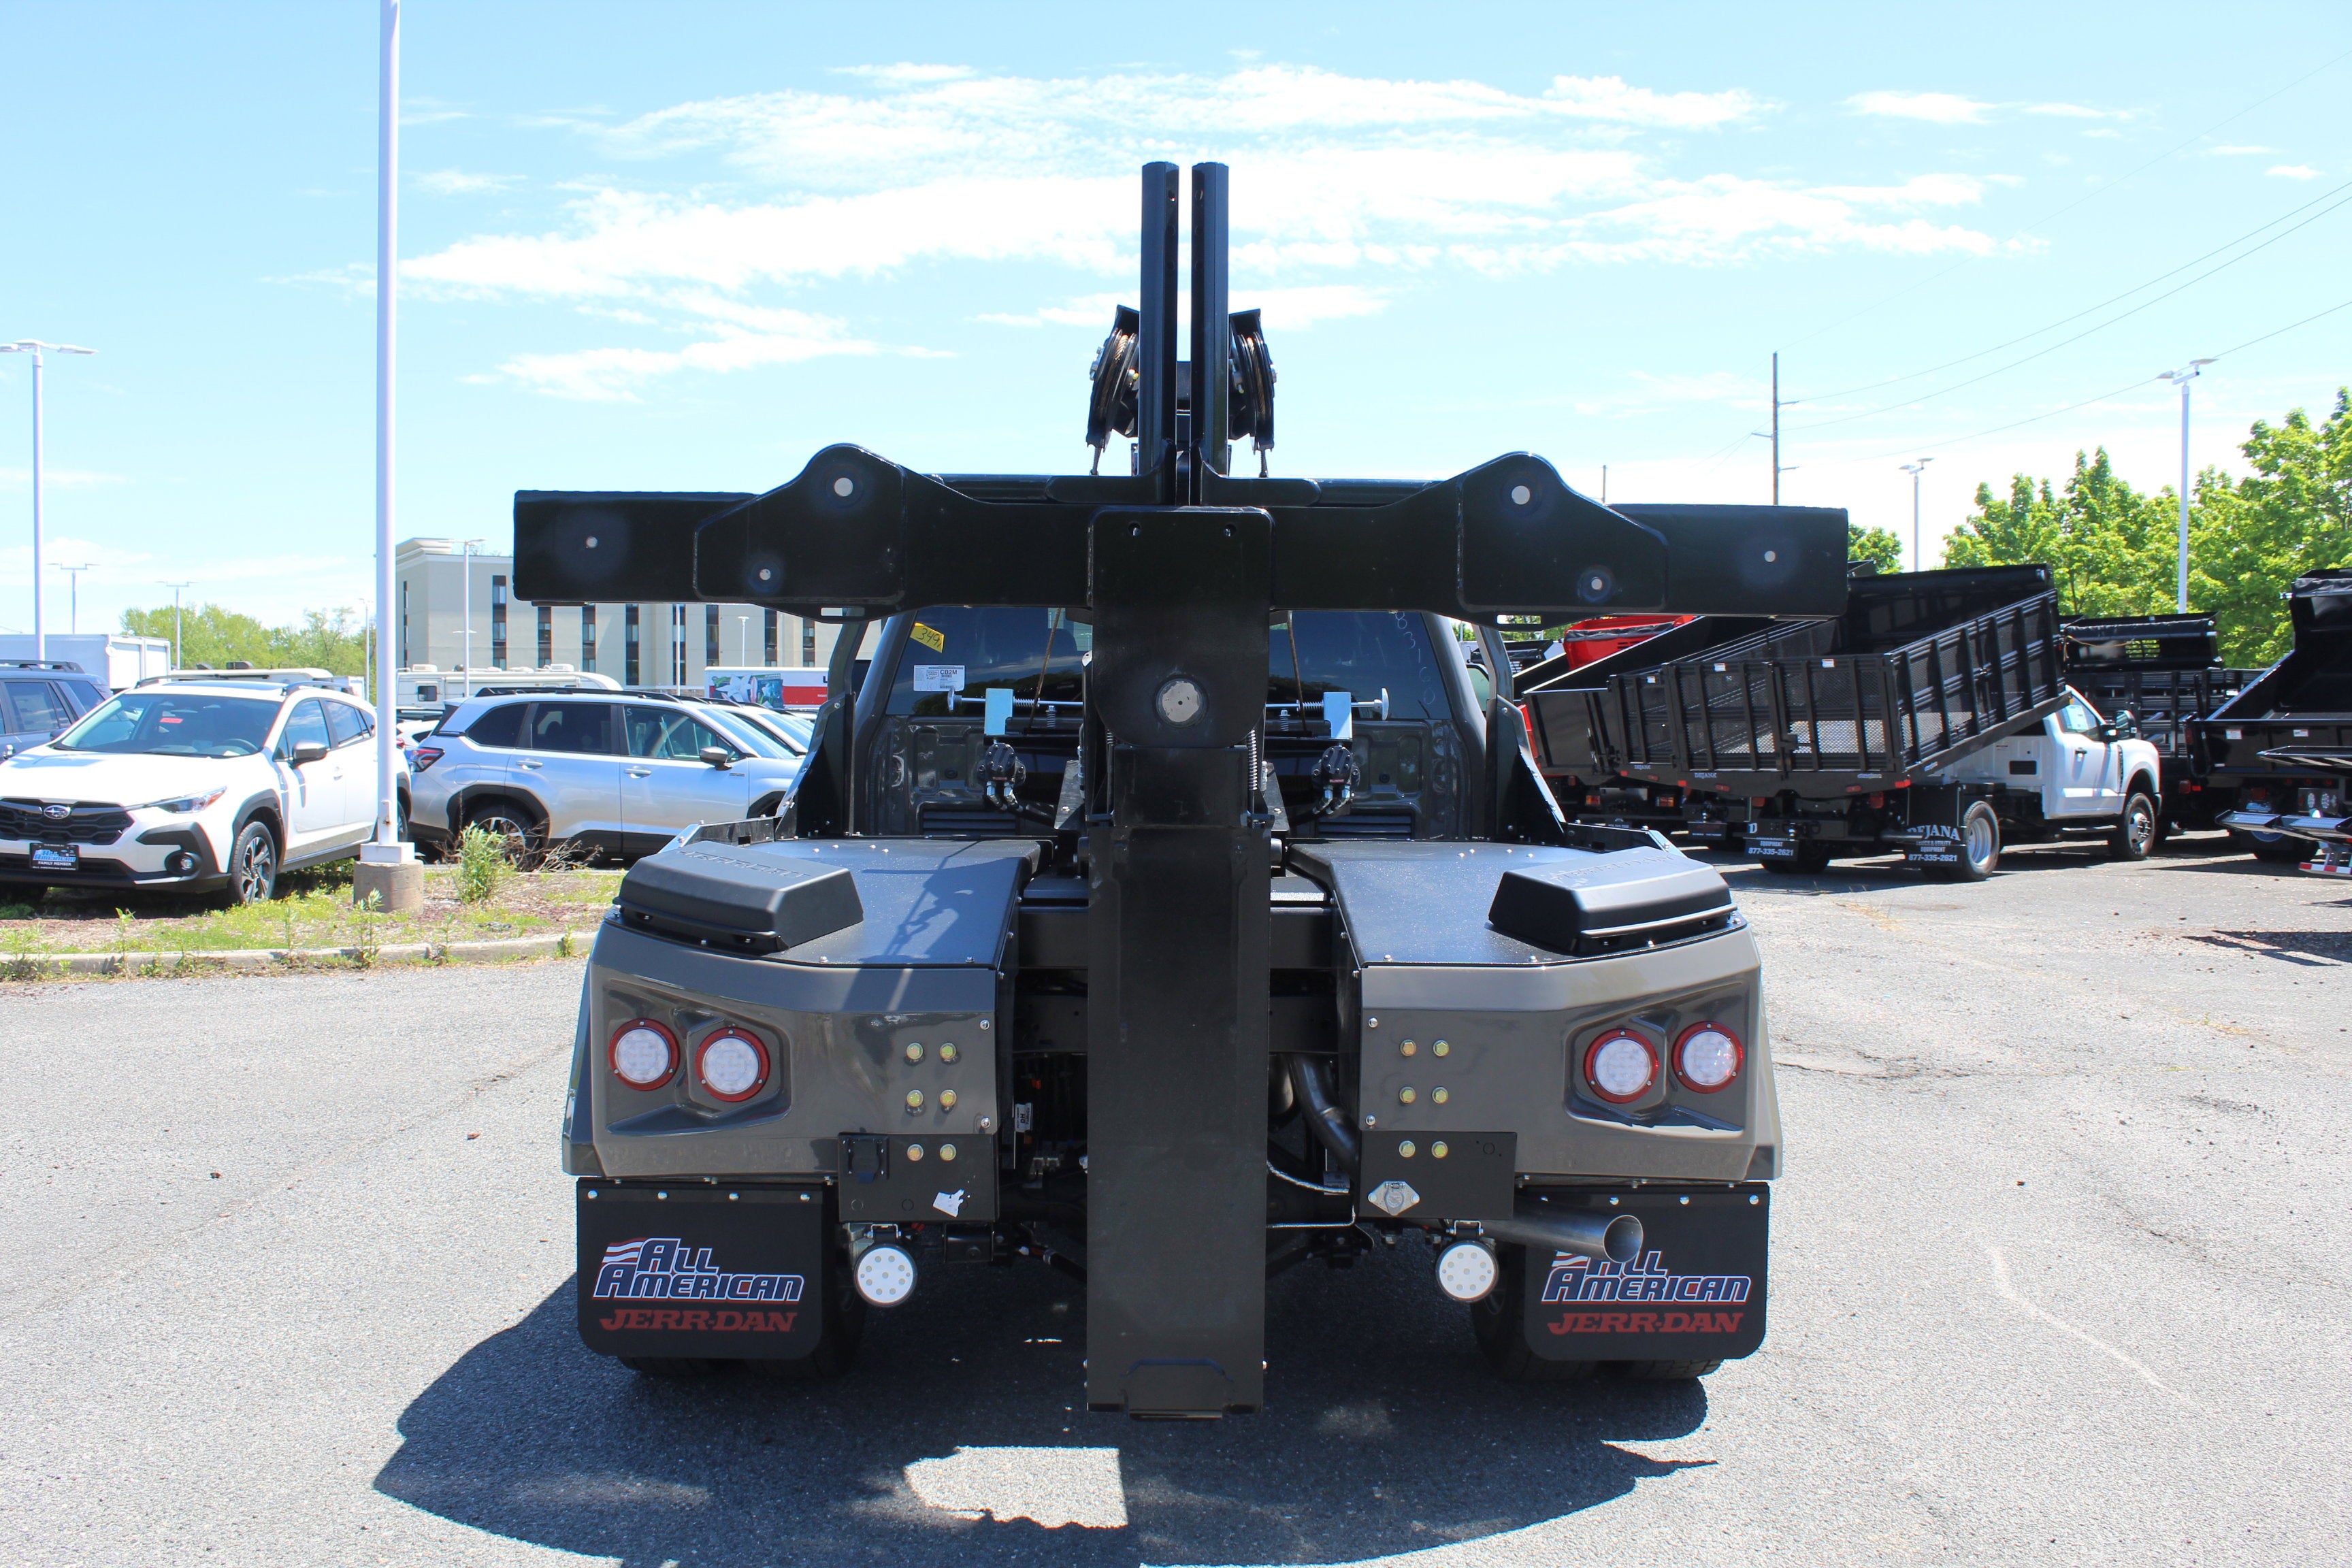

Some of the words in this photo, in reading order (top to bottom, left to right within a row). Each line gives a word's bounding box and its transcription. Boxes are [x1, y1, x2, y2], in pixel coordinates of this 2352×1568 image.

[1748, 847, 1793, 856] 877-335-2621
[1908, 853, 1957, 862] 877-335-2621
[636, 1237, 719, 1274] ALL
[593, 1262, 805, 1303] AMERICAN
[1541, 1266, 1752, 1305] AMERICAN
[599, 1309, 797, 1333] JERR-DAN
[1548, 1312, 1744, 1335] JERR-DAN
